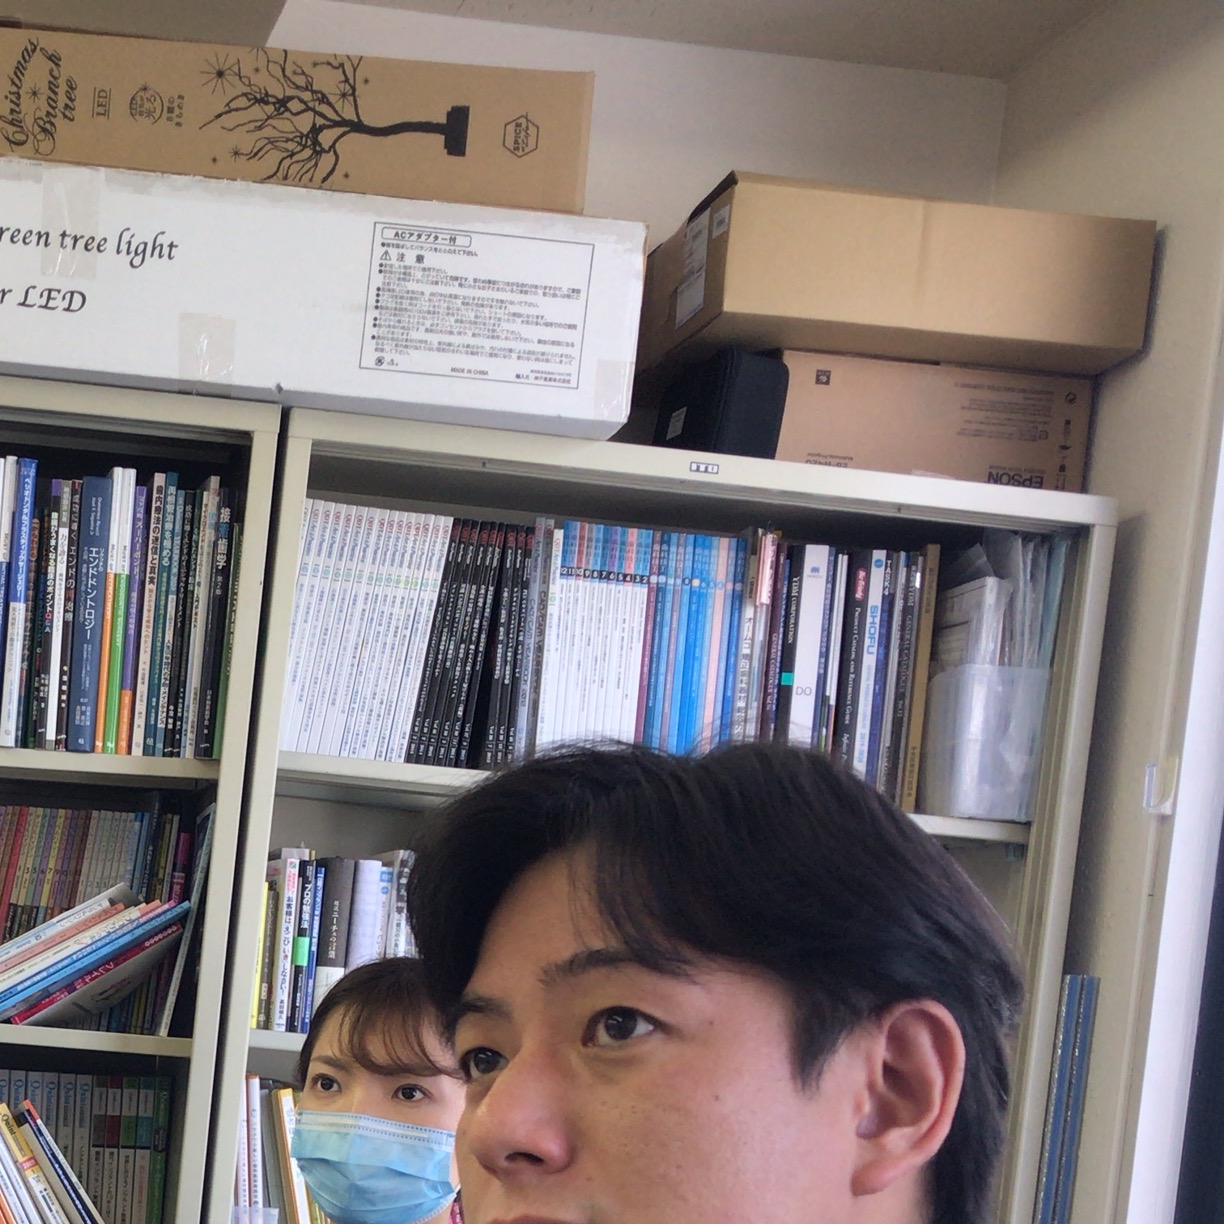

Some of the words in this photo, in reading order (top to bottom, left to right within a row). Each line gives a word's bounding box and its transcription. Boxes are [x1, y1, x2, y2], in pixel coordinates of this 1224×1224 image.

[0, 37, 40, 153] Christmas
[24, 47, 62, 156] Branch
[59, 75, 77, 122] tree
[96, 88, 108, 117] LED
[145, 95, 157, 120] 光る
[513, 122, 522, 153] SPICE
[60, 229, 108, 254] tree
[114, 225, 179, 268] light
[17, 284, 87, 313] LED
[987, 470, 1044, 489] EPSON
[148, 485, 163, 586] 歯内療法の迷信と真実
[216, 507, 231, 569] 接着歯学
[84, 547, 99, 640] エンドドントロジー
[791, 576, 800, 596] YDM
[536, 591, 546, 637] CAD/CAM
[787, 598, 797, 643] CORPORATION
[867, 605, 880, 655] SHOFU
[903, 615, 912, 647] GENERAL
[795, 686, 812, 696] DO
[899, 649, 909, 692] CATALOGUE
[328, 912, 340, 959] ニーチェの言葉
